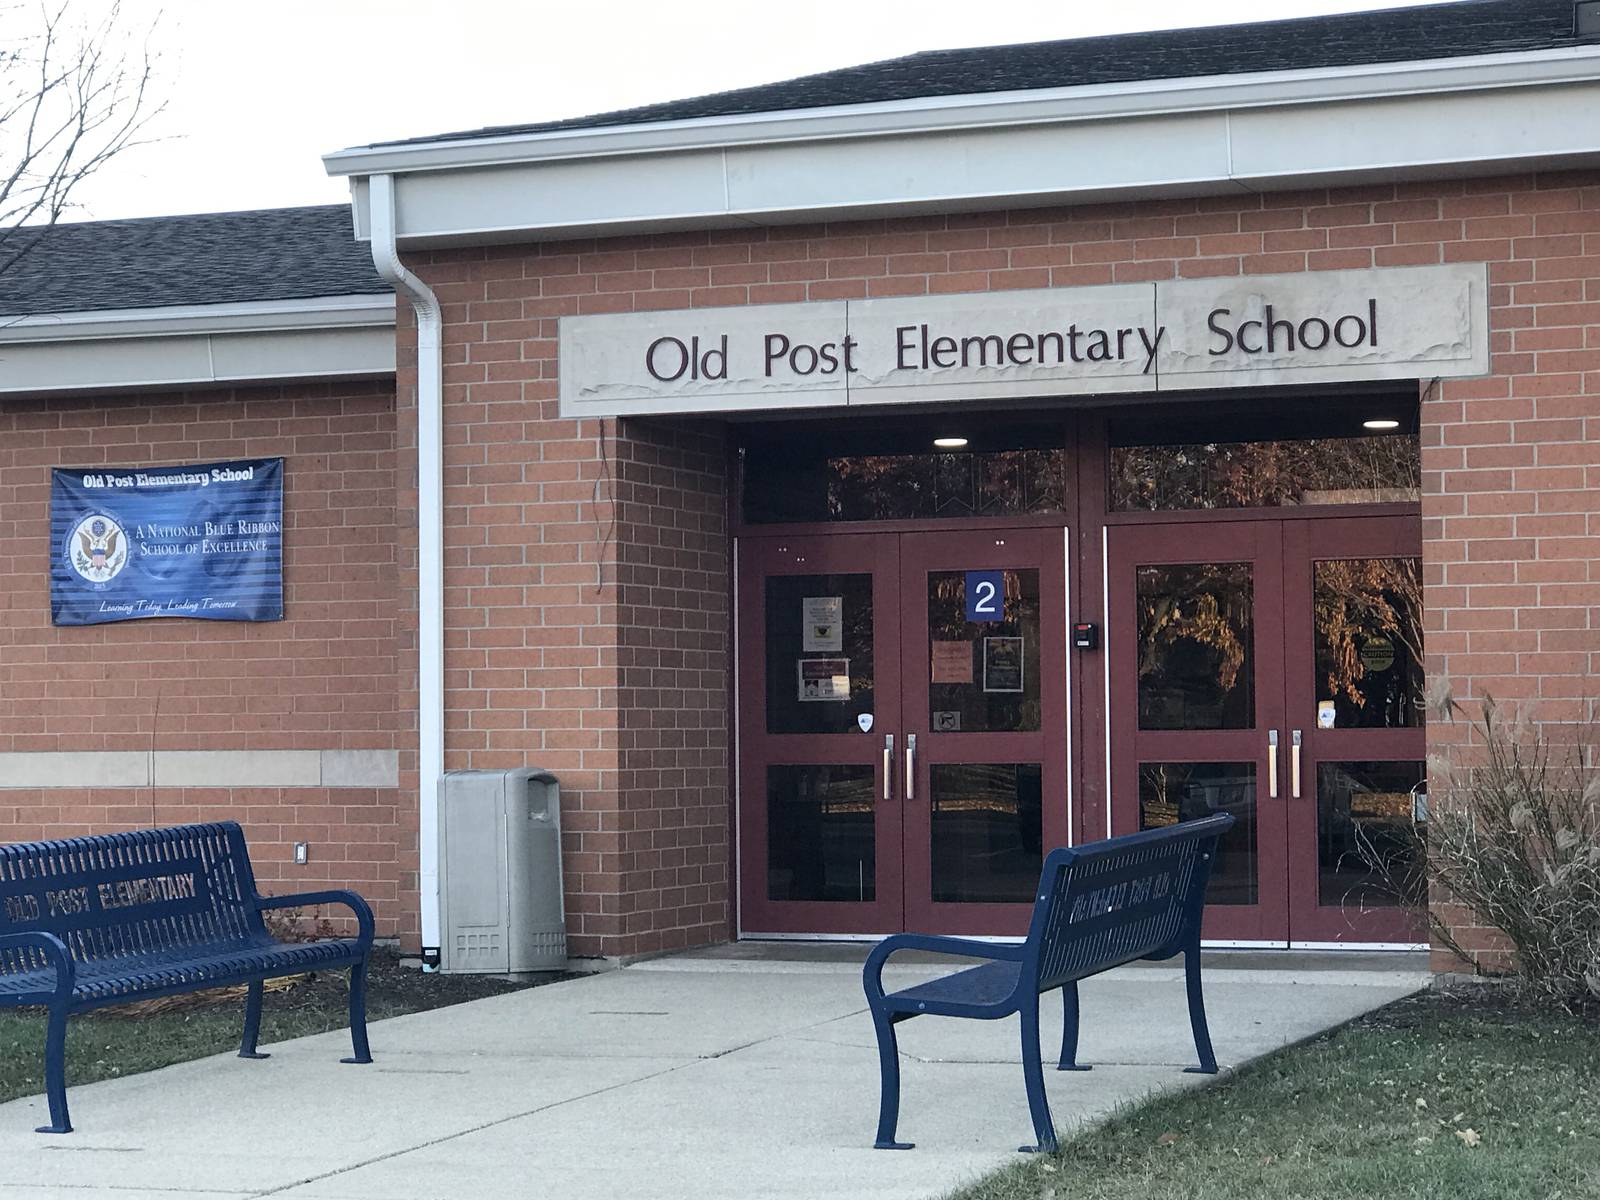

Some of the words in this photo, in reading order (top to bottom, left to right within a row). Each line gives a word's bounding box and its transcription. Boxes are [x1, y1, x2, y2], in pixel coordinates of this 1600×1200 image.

[646, 334, 728, 382] Old
[764, 333, 858, 377] Post
[896, 323, 1165, 375] Elementary
[1207, 298, 1377, 356] School
[83, 474, 104, 488] Old
[106, 475, 134, 488] Post
[135, 472, 209, 487] Elementary
[211, 466, 253, 482] School
[136, 525, 144, 539] A
[147, 523, 201, 538] NATIONAL
[205, 521, 234, 536] BLUE
[238, 520, 280, 534] RIBBON
[140, 541, 183, 556] SCHOOL
[202, 539, 268, 554] EXCELLENCE
[99, 600, 134, 614] Learning
[167, 598, 199, 613] Leading
[975, 581, 996, 612] 2
[6, 894, 40, 923] OLD
[46, 886, 91, 917] POST
[97, 872, 196, 910] ELEMENTARY
